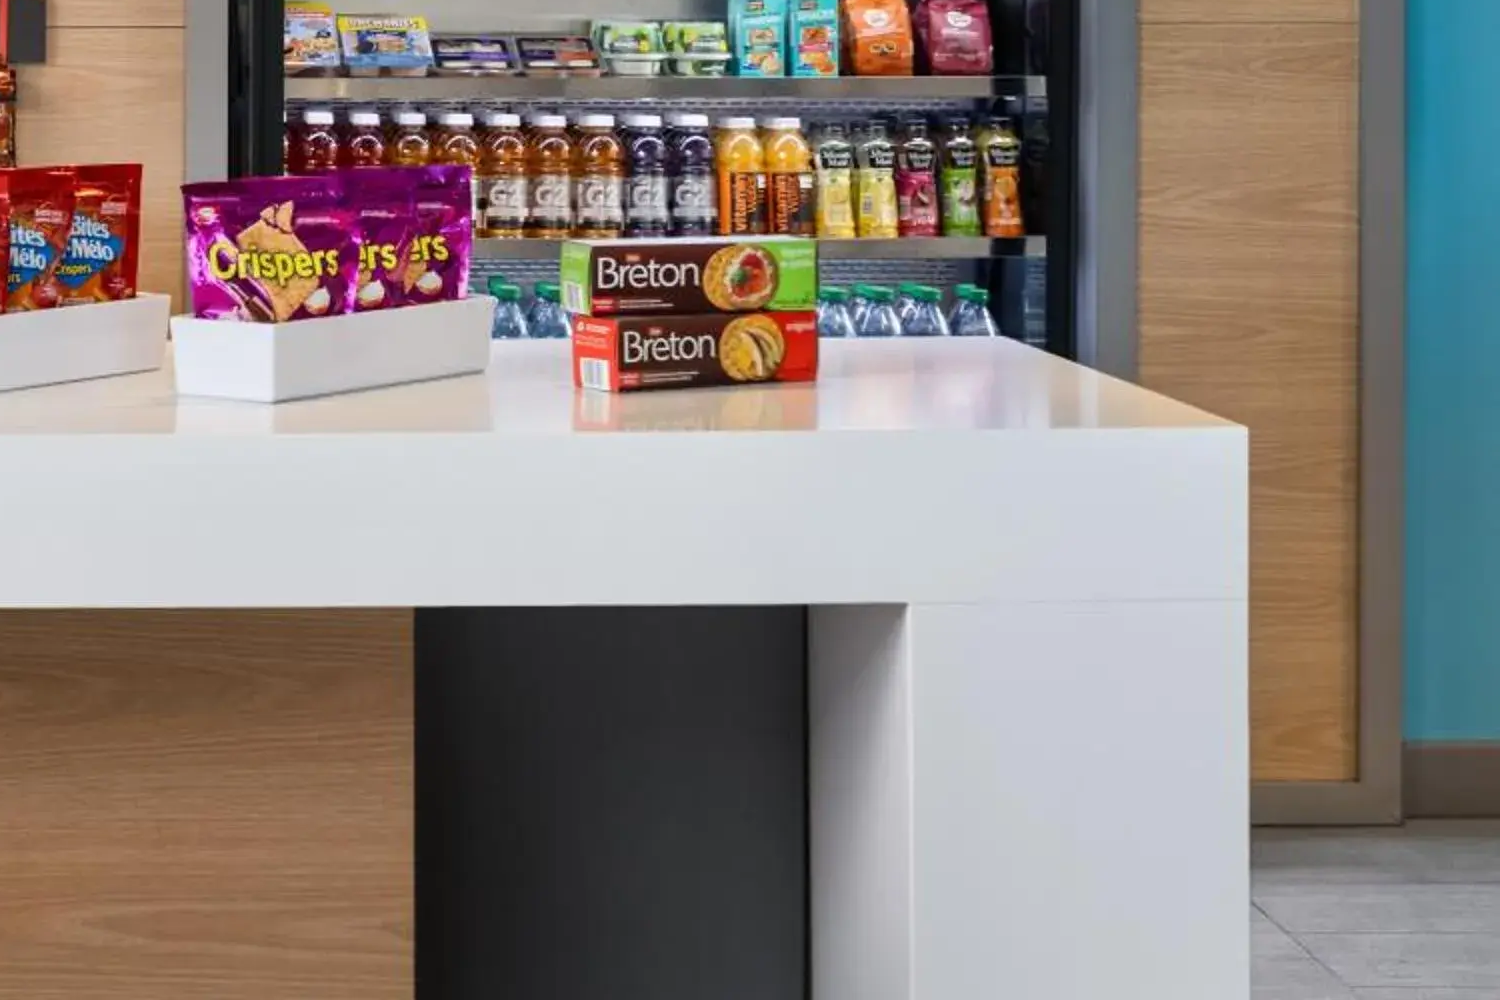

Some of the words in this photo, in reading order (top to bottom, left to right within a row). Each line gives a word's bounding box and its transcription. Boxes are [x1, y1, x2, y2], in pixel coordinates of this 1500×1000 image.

[8, 223, 46, 247] ites
[209, 242, 340, 288] Crispers
[596, 256, 699, 289] Breton
[623, 330, 716, 363] Breton
